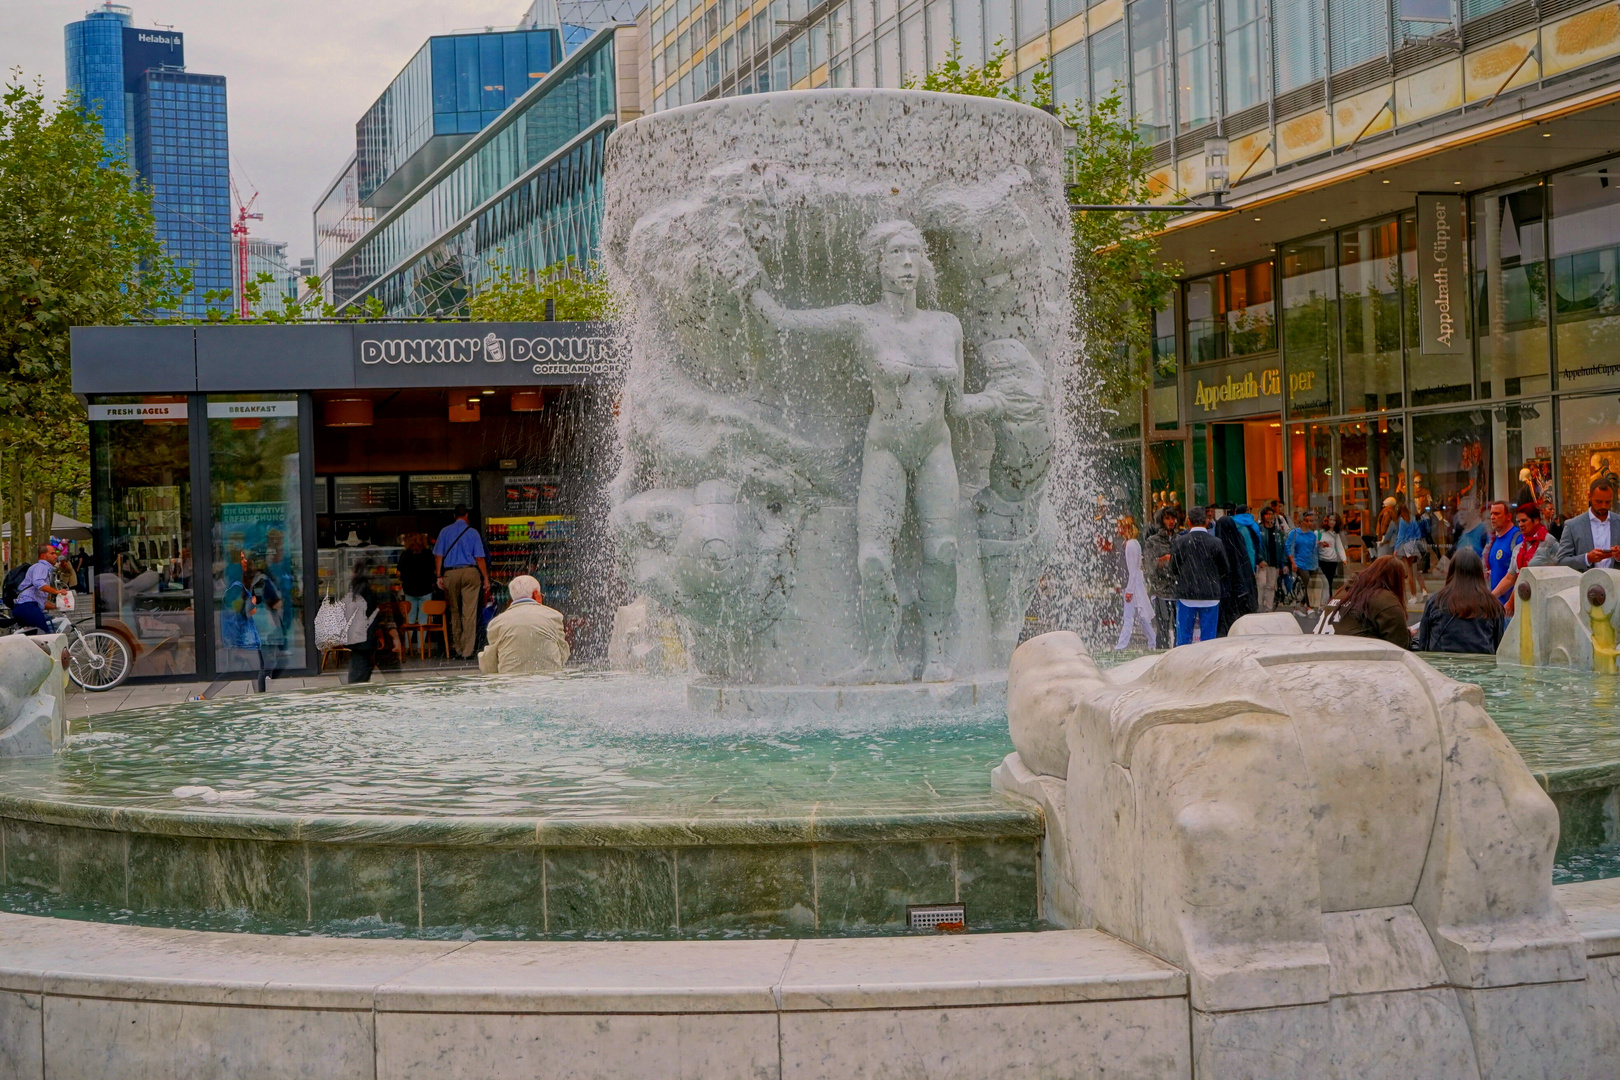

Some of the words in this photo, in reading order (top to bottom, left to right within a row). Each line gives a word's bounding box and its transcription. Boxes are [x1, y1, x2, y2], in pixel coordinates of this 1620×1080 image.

[138, 33, 170, 44] Helaba
[1434, 201, 1454, 348] Appelrath-Cüpper
[361, 338, 480, 364] DUNKIN'
[510, 337, 622, 361] DONUTS
[533, 364, 570, 374] COFFEE
[570, 363, 592, 373] AND
[592, 363, 620, 373] MORE
[1563, 363, 1620, 381] AppelrathCüppe
[1194, 369, 1315, 411] Appelrath-Cüper
